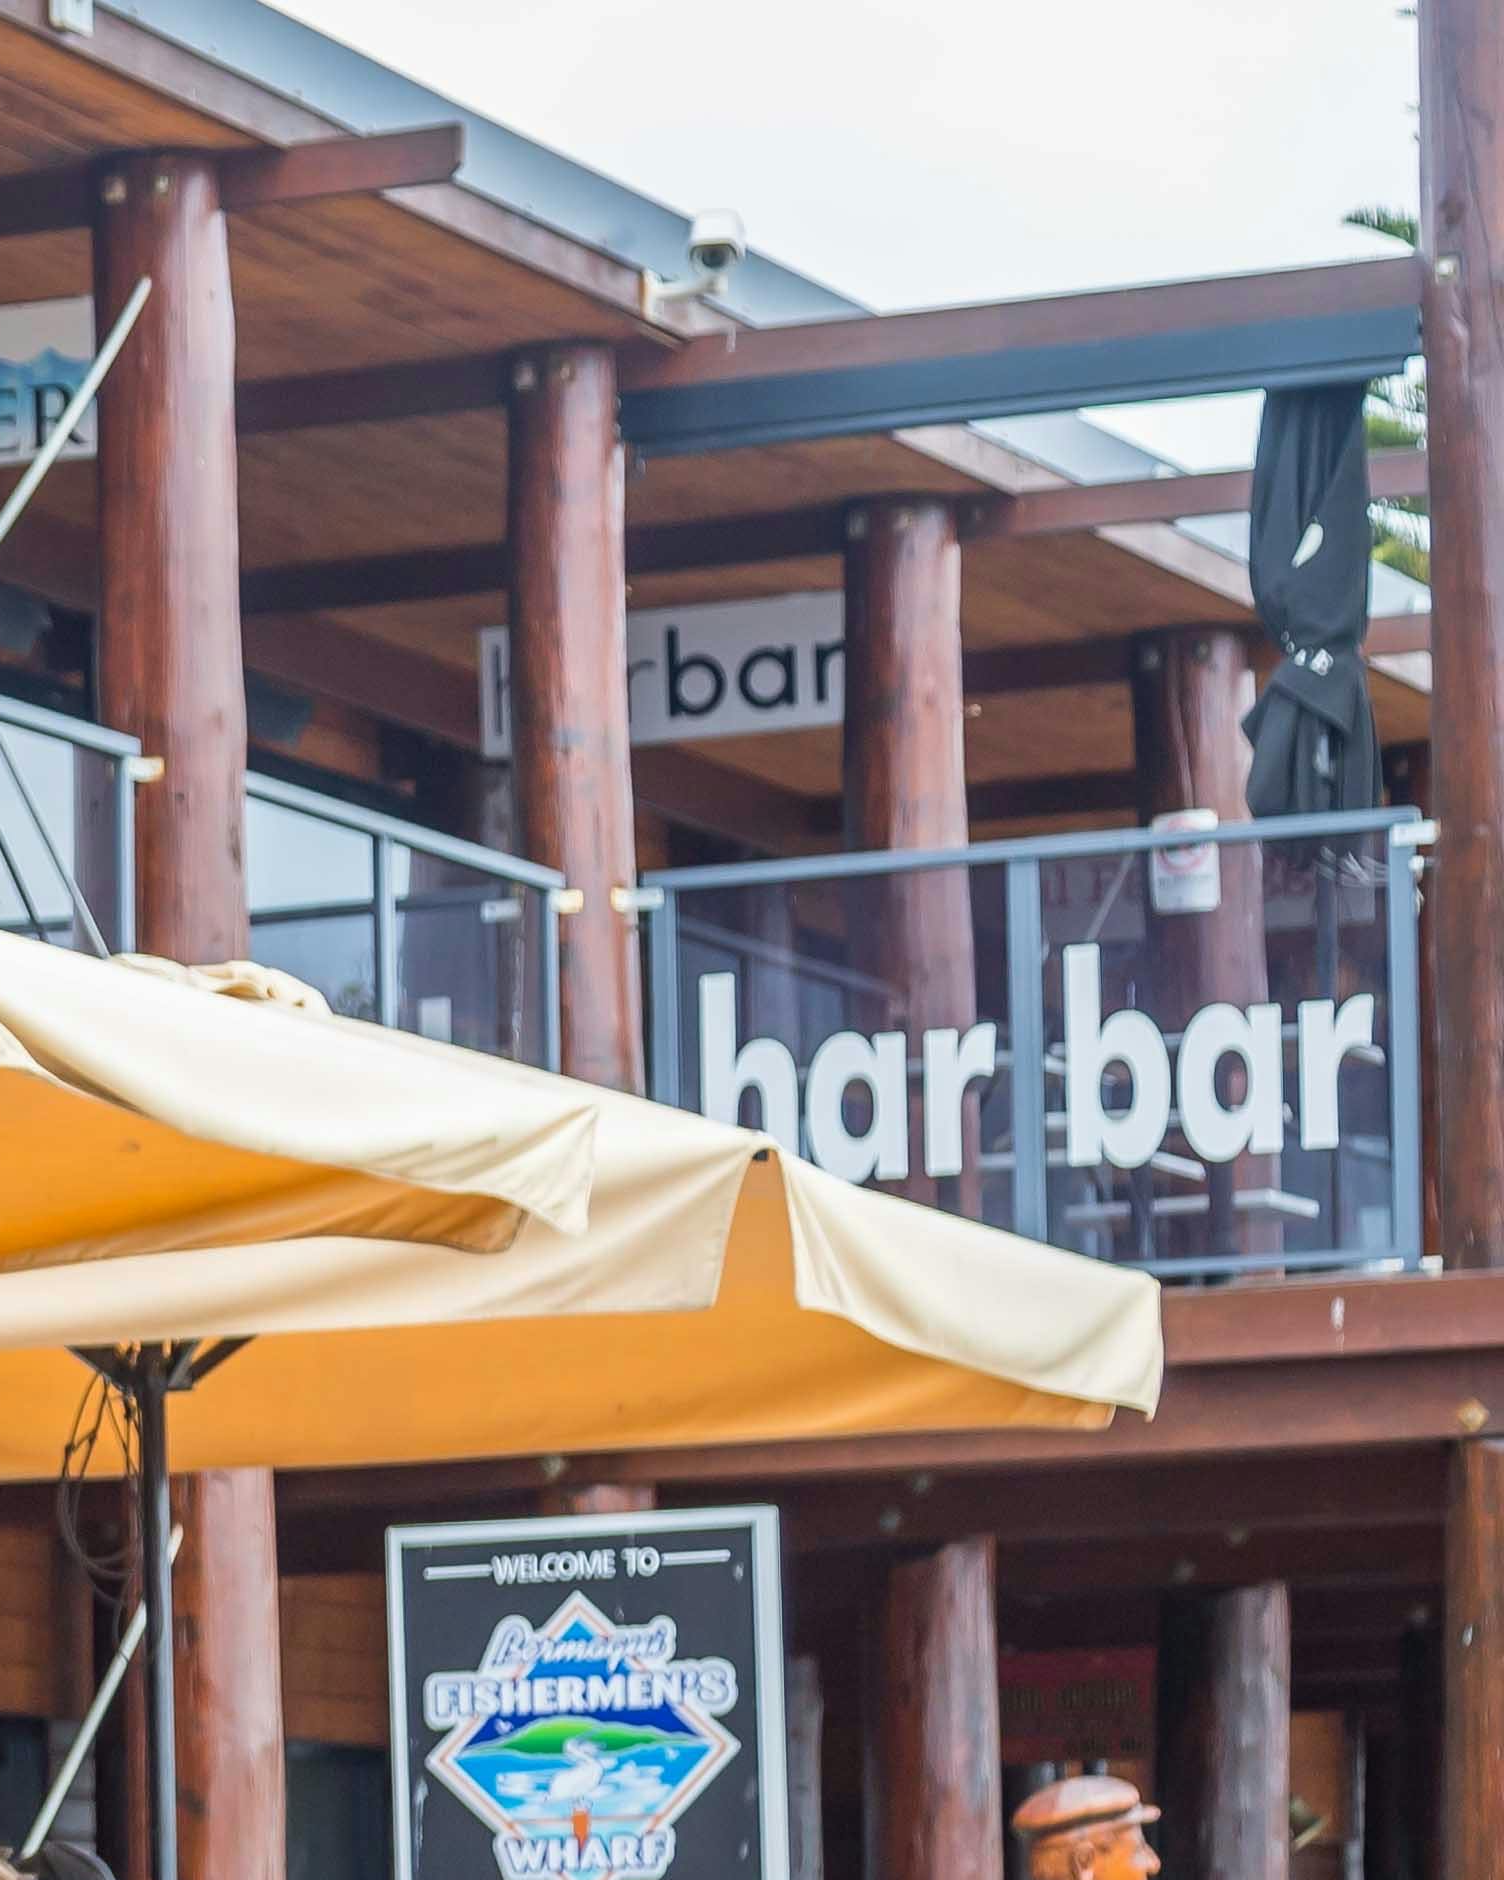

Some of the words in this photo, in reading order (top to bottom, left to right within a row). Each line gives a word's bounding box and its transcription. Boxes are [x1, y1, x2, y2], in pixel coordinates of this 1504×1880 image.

[699, 971, 997, 1185] har
[1063, 942, 1374, 1169] bar
[490, 1549, 617, 1586] WELCOME
[624, 1546, 662, 1579] TO
[432, 1664, 731, 1717] FISHERMEN'S
[503, 1831, 672, 1874] WHARF
